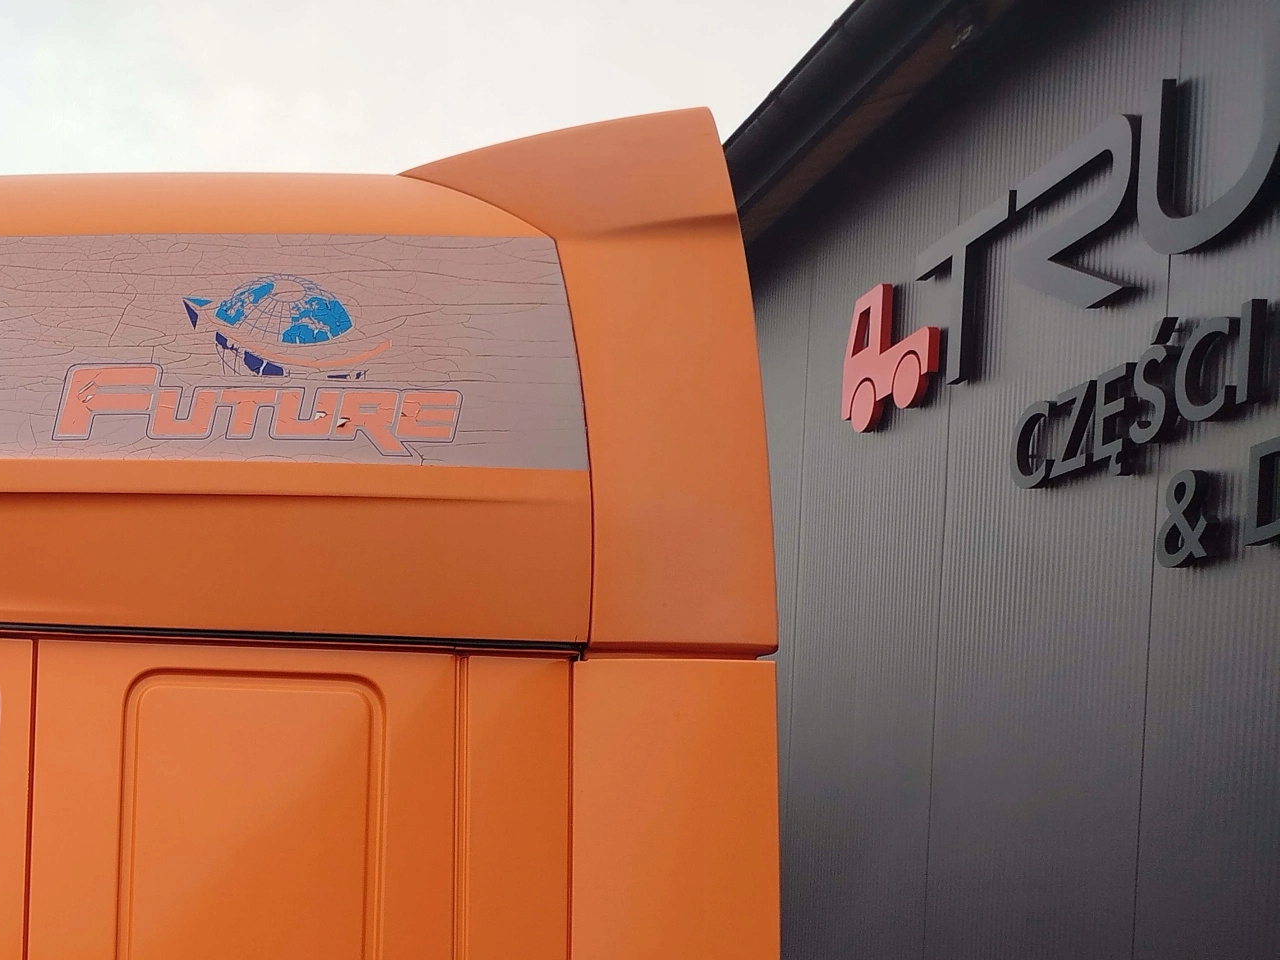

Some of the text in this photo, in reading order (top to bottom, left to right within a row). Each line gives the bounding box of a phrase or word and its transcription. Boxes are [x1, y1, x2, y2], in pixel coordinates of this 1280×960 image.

[52, 362, 463, 457] FUTURE
[1010, 299, 1267, 489] CZĘŚCI
[1156, 469, 1210, 568] &
